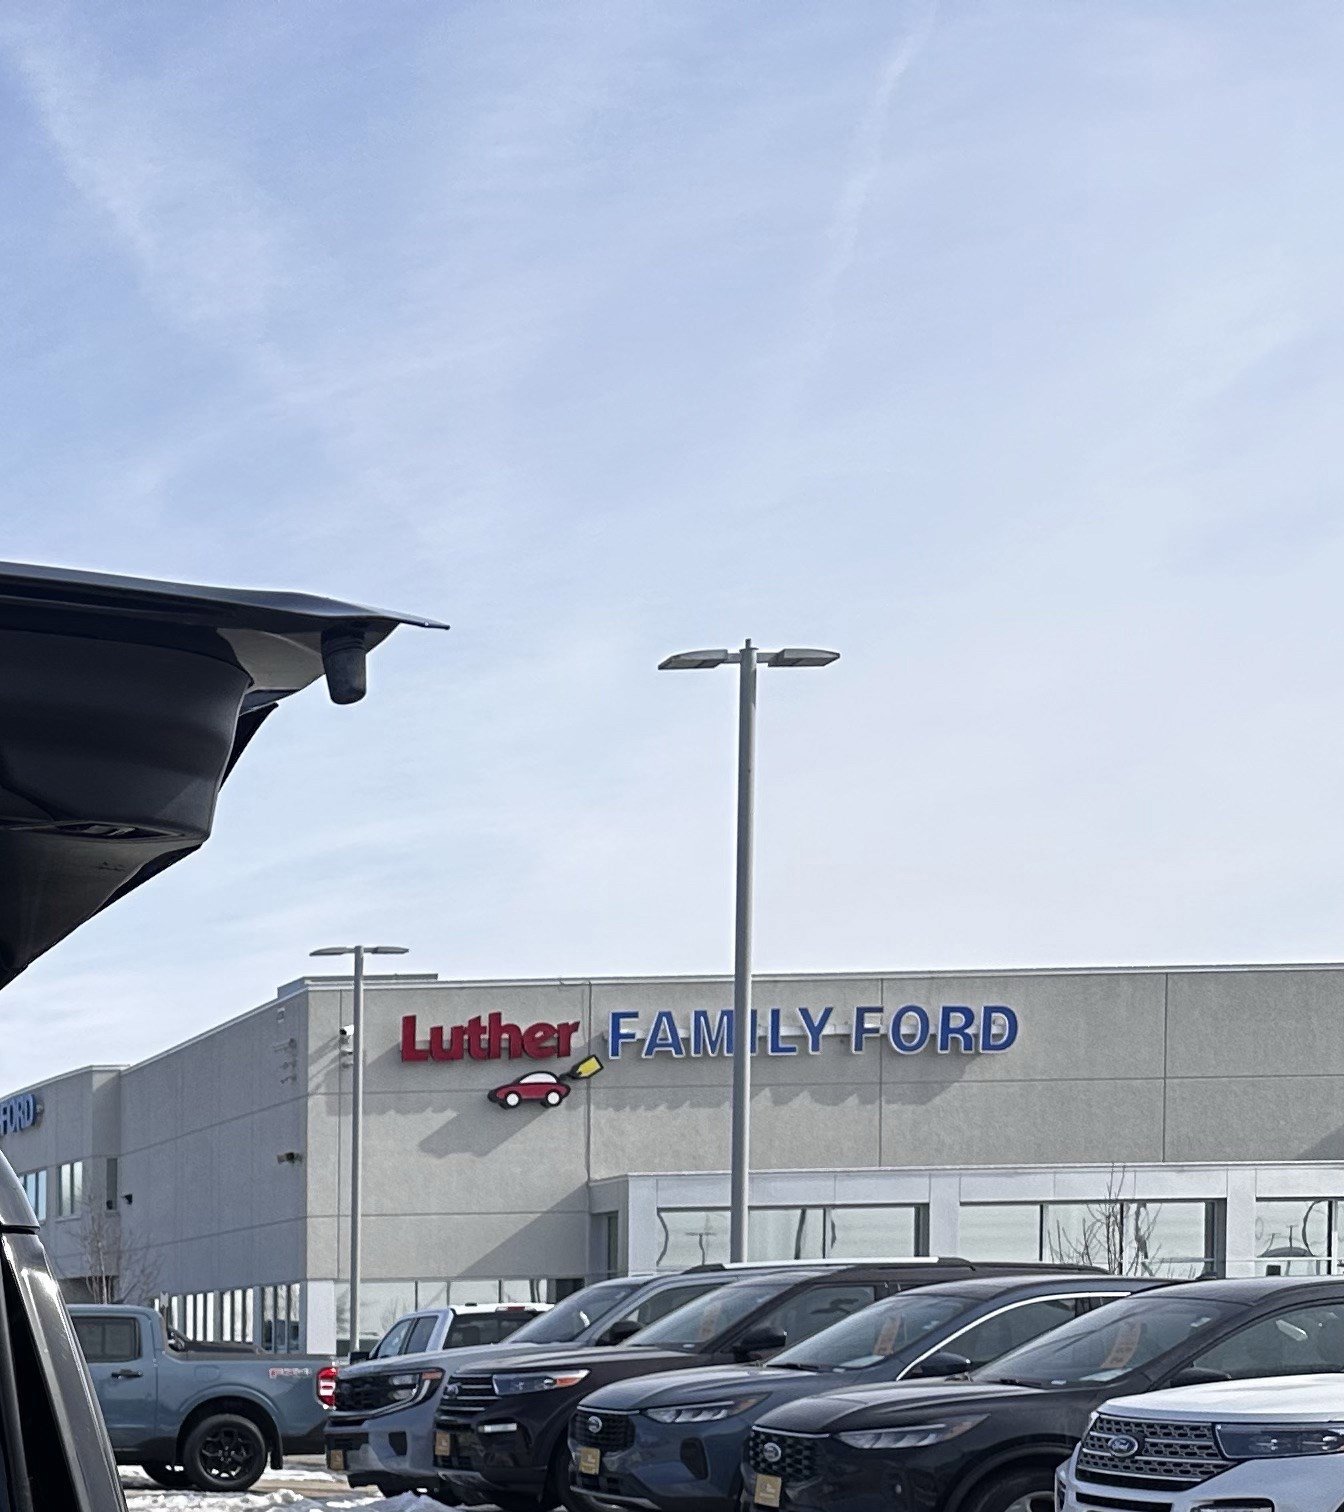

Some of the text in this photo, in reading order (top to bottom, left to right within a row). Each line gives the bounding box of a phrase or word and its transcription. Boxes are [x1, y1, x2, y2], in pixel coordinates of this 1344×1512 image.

[400, 1011, 580, 1063] Luther
[608, 1003, 1019, 1059] FAMILY FORD
